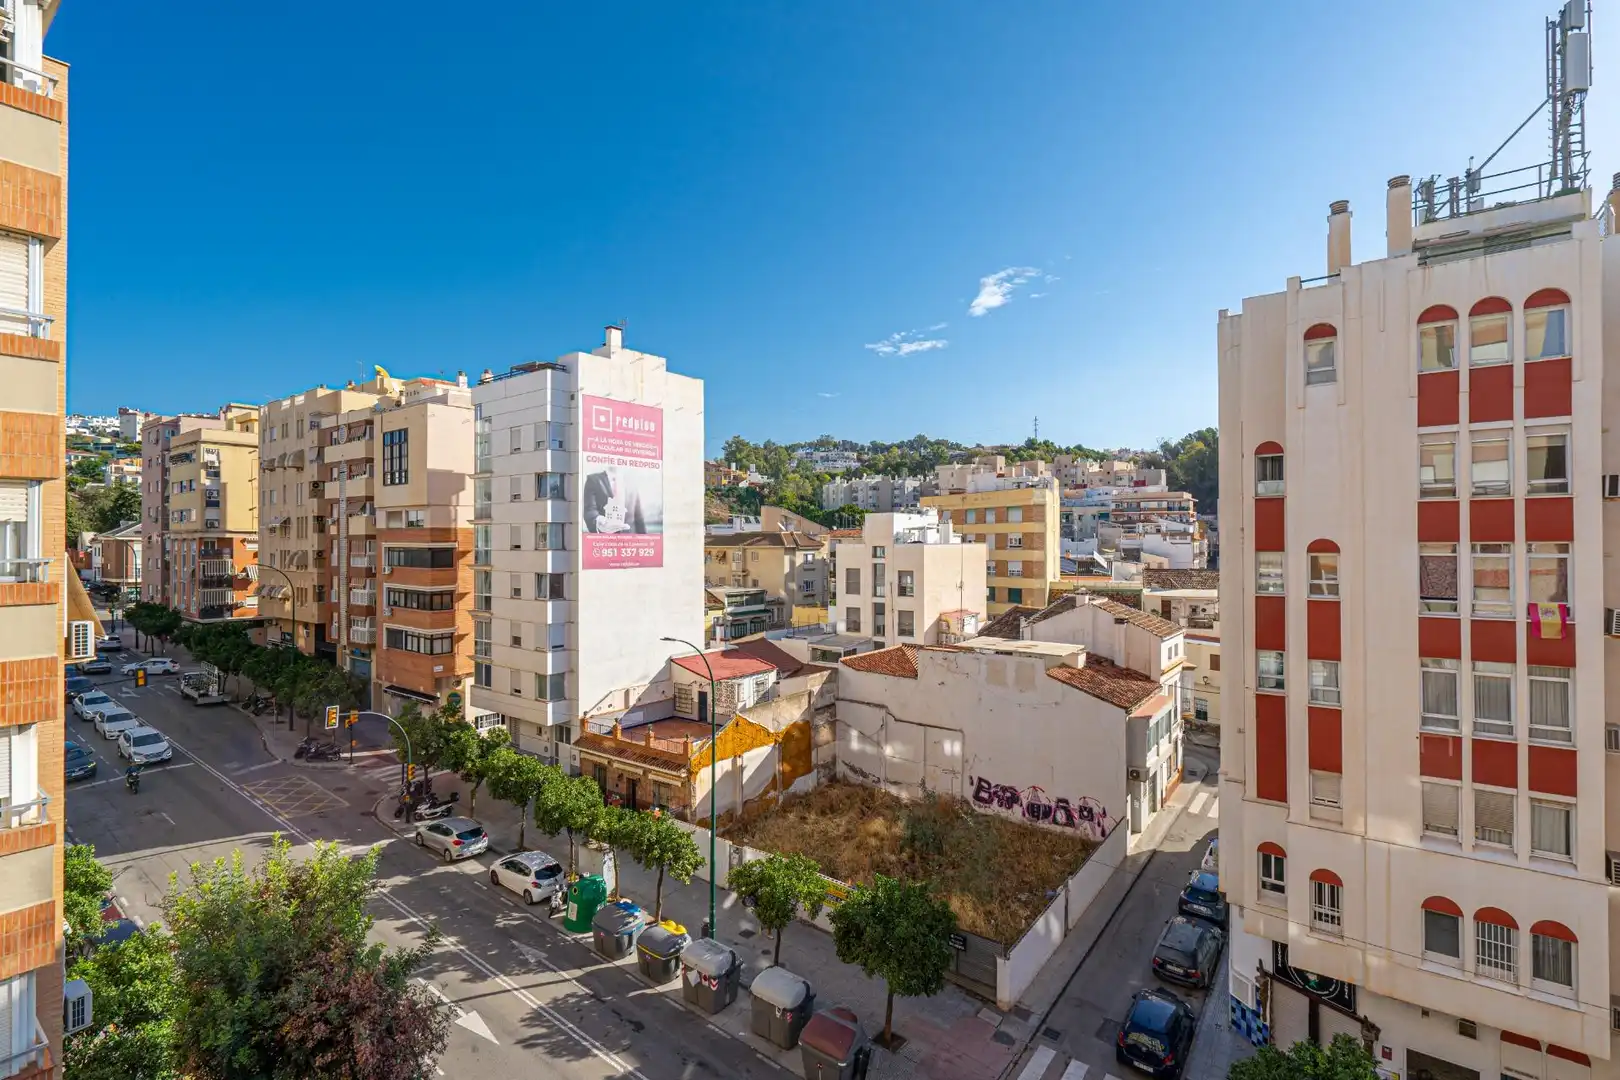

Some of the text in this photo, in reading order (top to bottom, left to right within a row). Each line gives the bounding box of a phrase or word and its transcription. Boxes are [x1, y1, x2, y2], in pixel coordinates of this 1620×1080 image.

[616, 416, 656, 432] redpiso
[617, 458, 628, 466] EN
[629, 459, 661, 470] REDPISO
[601, 547, 655, 557] 951 337 929
